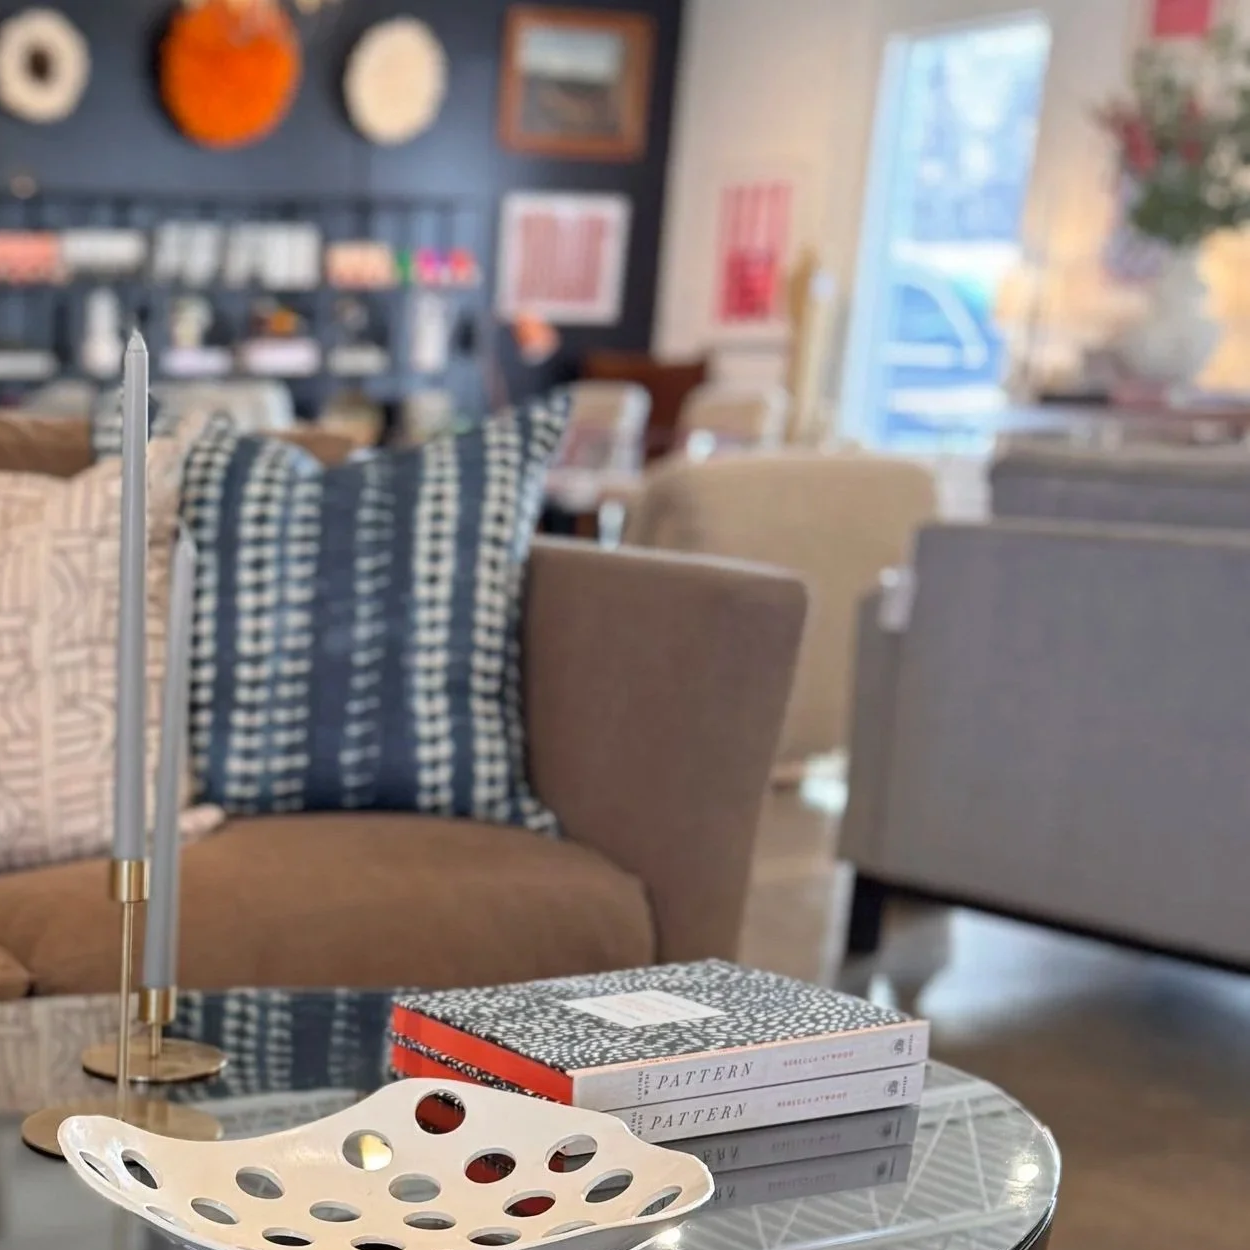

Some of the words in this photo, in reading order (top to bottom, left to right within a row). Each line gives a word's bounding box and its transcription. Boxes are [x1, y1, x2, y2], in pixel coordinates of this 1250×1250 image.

[783, 1056, 819, 1068] REBECCA
[821, 1050, 855, 1062] ATWOOD
[656, 1061, 754, 1090] PATTERN
[777, 1097, 812, 1109] REBECCA
[650, 1102, 748, 1131] PATTERN
